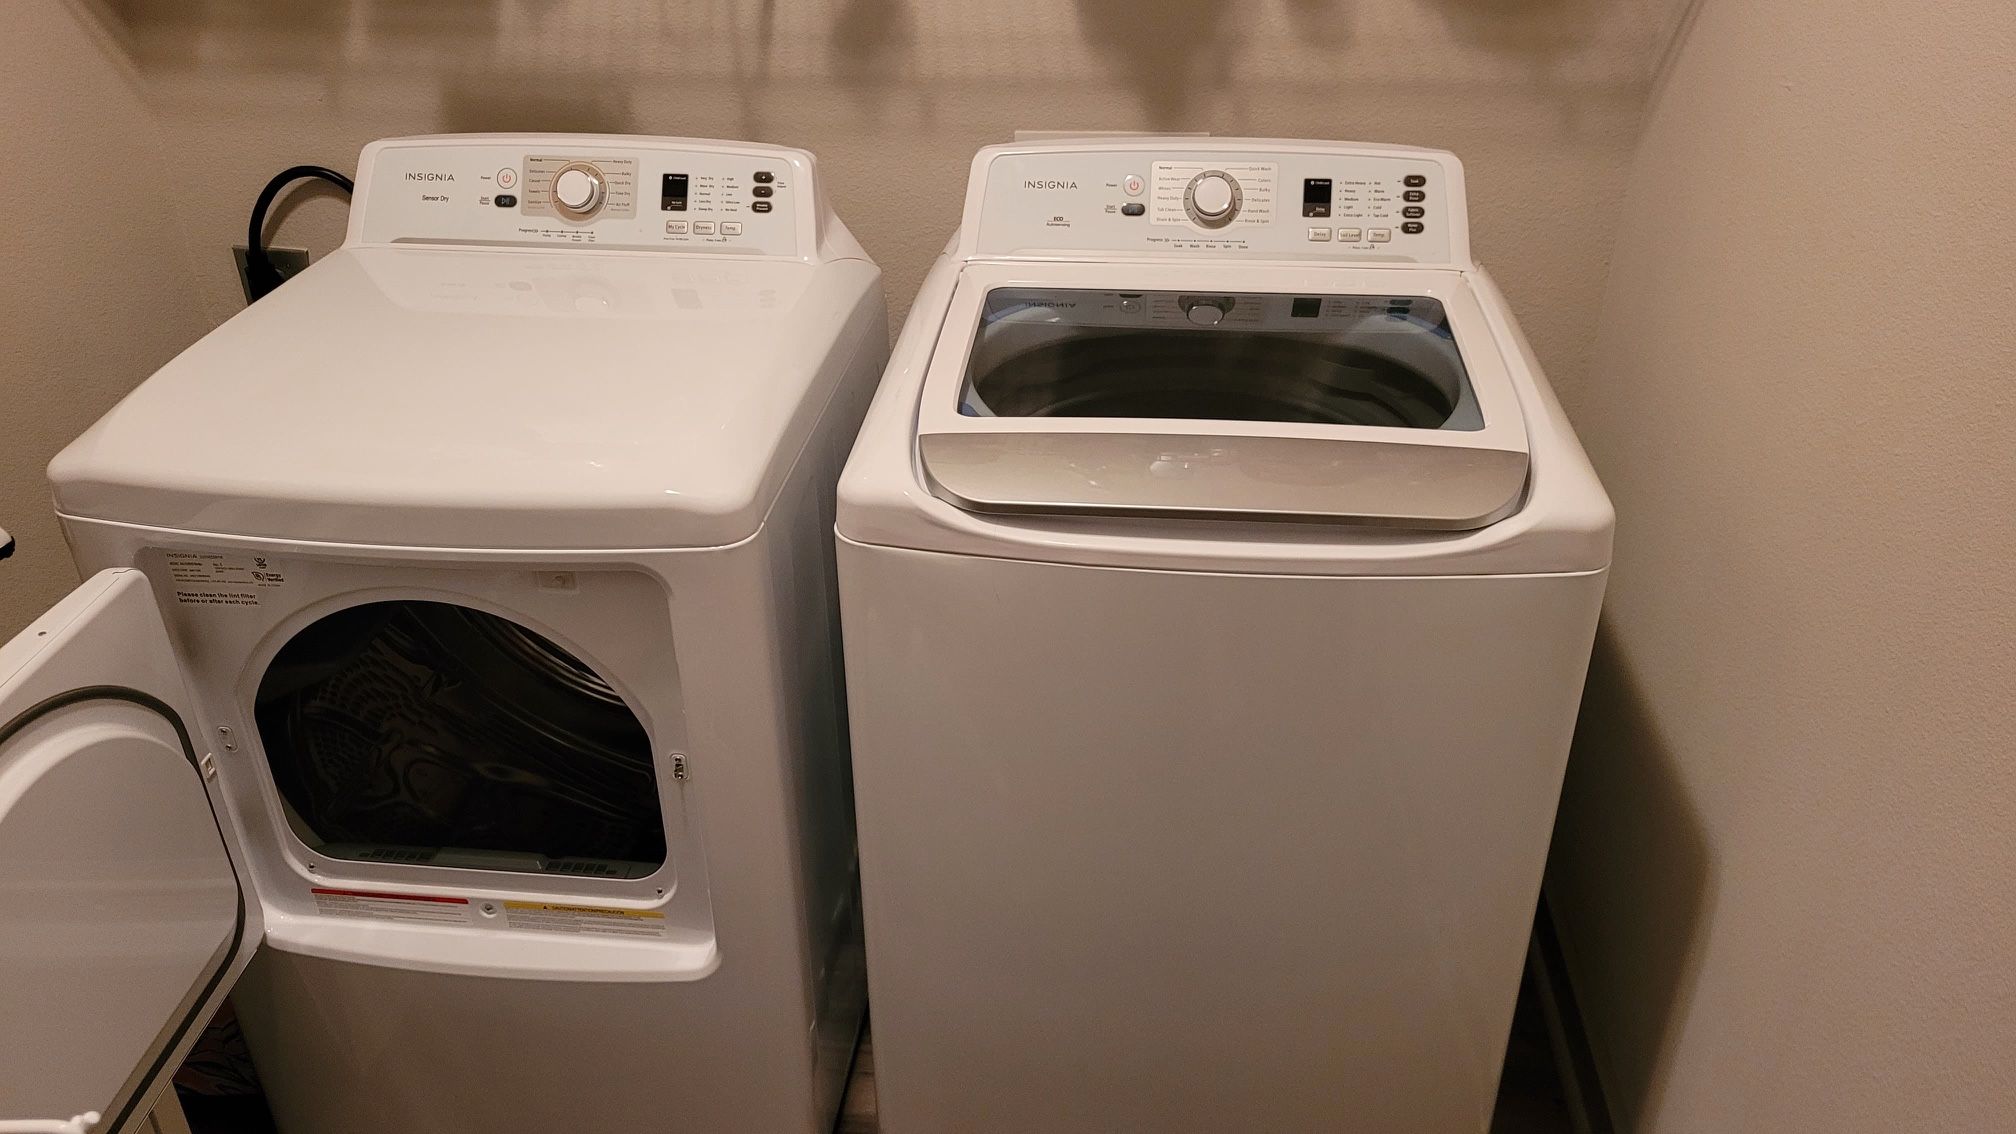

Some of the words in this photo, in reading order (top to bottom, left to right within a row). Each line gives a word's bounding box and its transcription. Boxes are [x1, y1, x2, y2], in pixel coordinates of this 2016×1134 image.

[405, 172, 455, 182] INSIGNIA
[1024, 180, 1078, 190] INSIGNIA
[696, 224, 712, 232] Dryness
